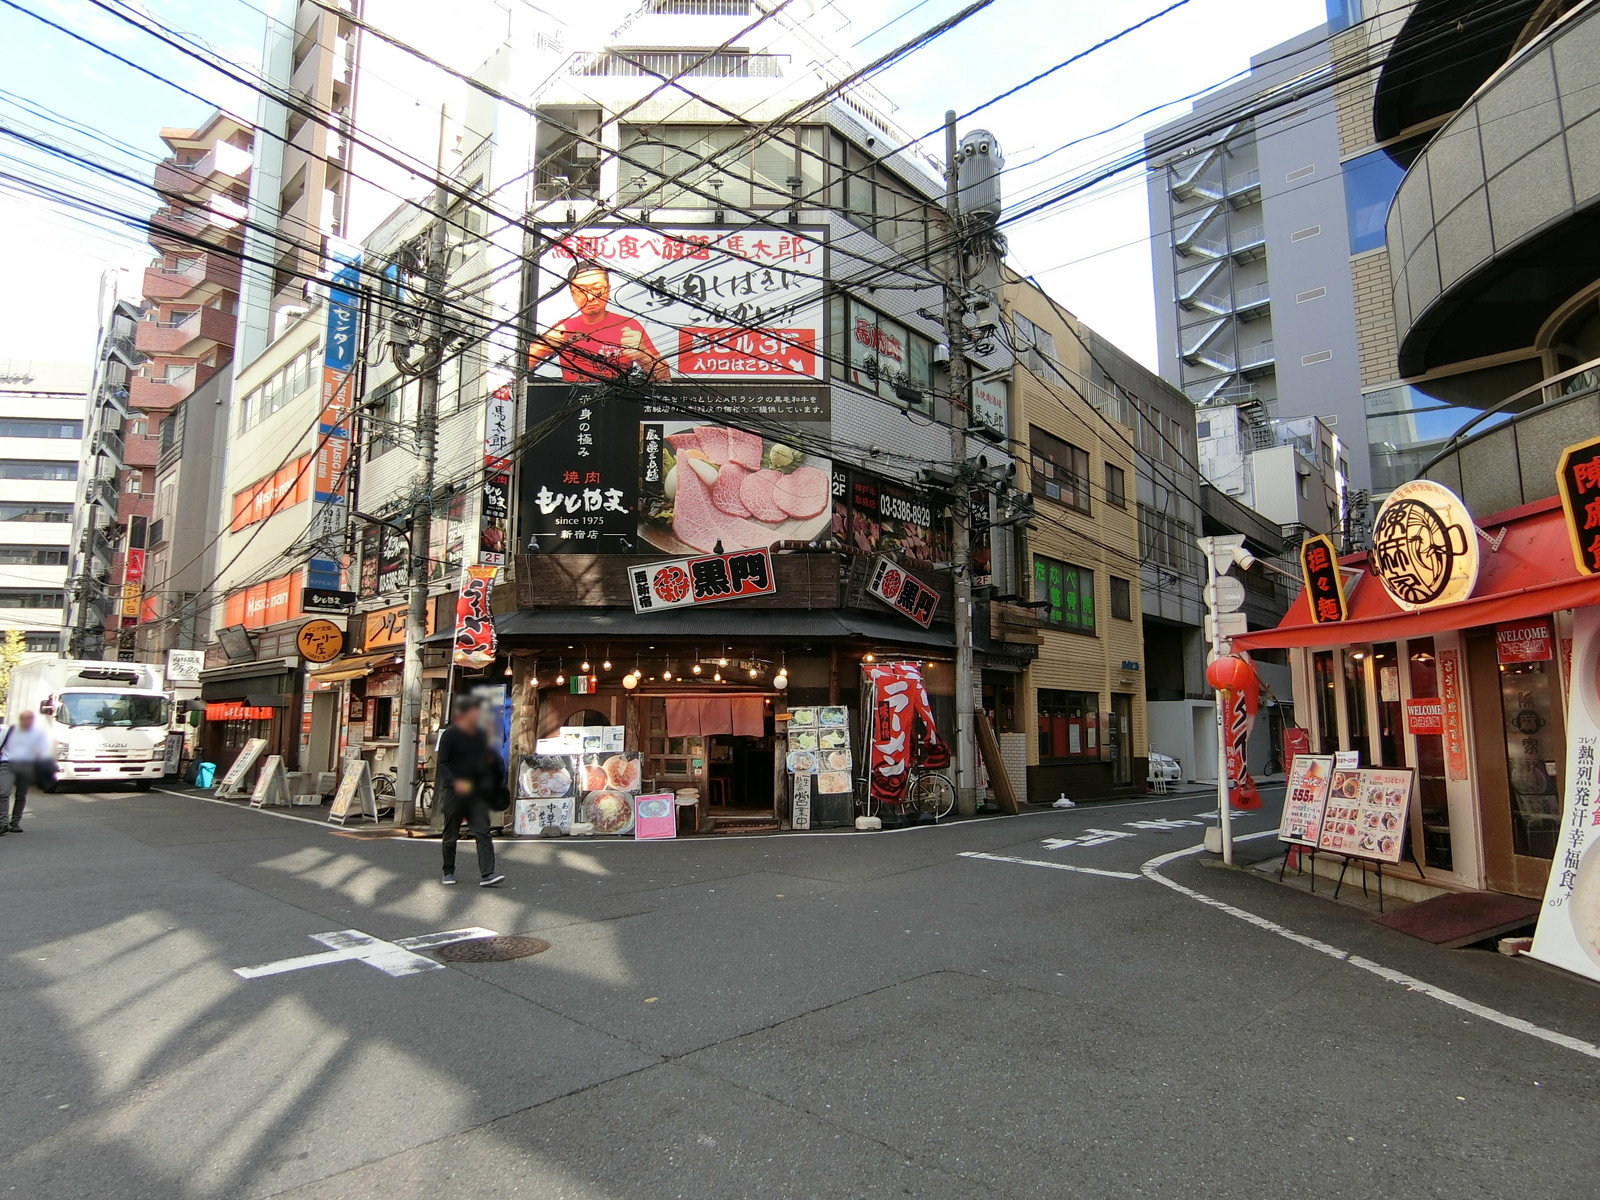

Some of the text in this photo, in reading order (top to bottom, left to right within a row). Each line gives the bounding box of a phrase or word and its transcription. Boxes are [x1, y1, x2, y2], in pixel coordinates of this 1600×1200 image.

[693, 358, 783, 372] 入り口はこちら
[489, 405, 507, 450] 馬太郎
[563, 471, 600, 484] 焼肉
[832, 472, 846, 482] 入口
[832, 482, 846, 496] 2F
[880, 494, 930, 528] 03-5386-8929
[555, 517, 604, 525] since 1975
[560, 530, 599, 540] 新宿店
[485, 552, 501, 563] 2F
[634, 570, 652, 608] 西新宿
[692, 552, 769, 598] 黒門
[976, 576, 988, 584] 2F
[1035, 561, 1076, 589] たなべ
[1308, 547, 1340, 622] 担々麺
[897, 579, 936, 623] 黒門
[1050, 587, 1092, 614] 整骨院
[302, 632, 339, 646] ターリー
[1496, 626, 1548, 644] WELCOME
[315, 644, 326, 655] 屋
[1407, 704, 1443, 716] WELCOME
[874, 680, 909, 777] ラーメン
[1292, 788, 1314, 804] 555円
[794, 791, 810, 828] 営業中
[1559, 744, 1594, 891] 熱烈発汗幸福食
